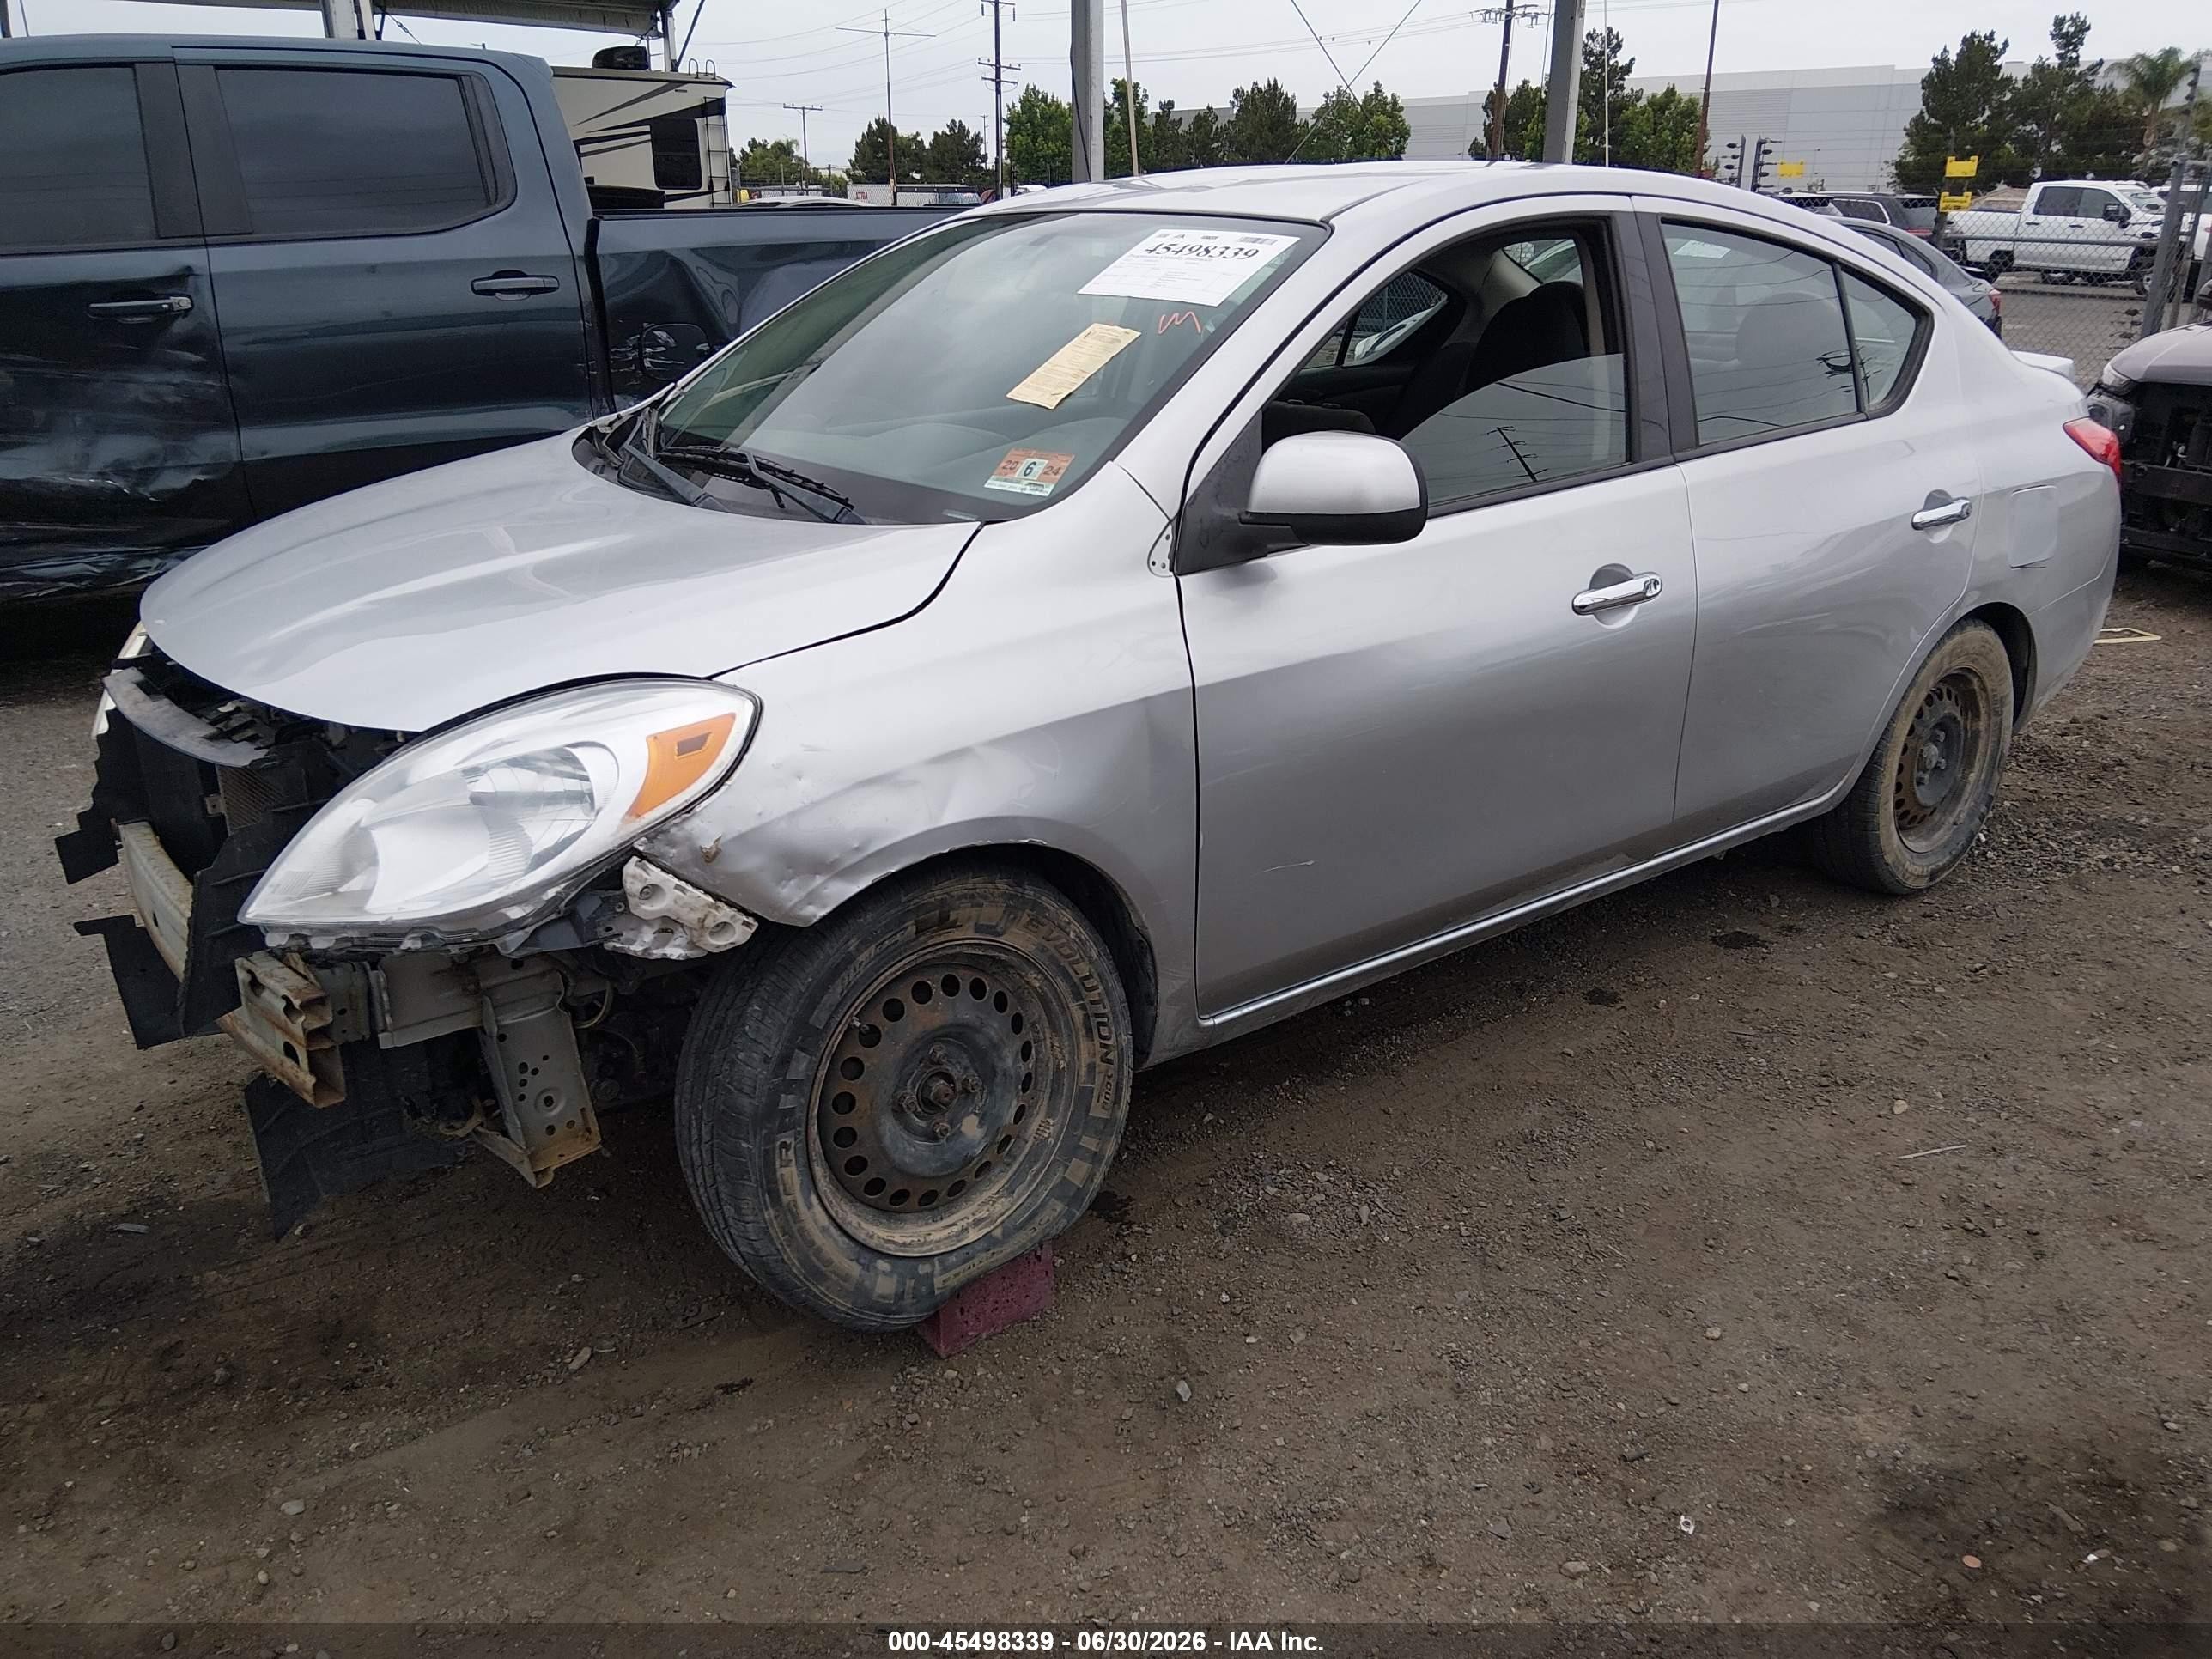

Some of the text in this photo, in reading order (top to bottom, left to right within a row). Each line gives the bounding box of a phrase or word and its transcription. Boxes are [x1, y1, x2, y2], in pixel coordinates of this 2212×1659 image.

[1146, 241, 1260, 260] 45498339
[1001, 459, 1062, 477] 20 6 24
[1023, 918, 1115, 1066] EVOLUTION
